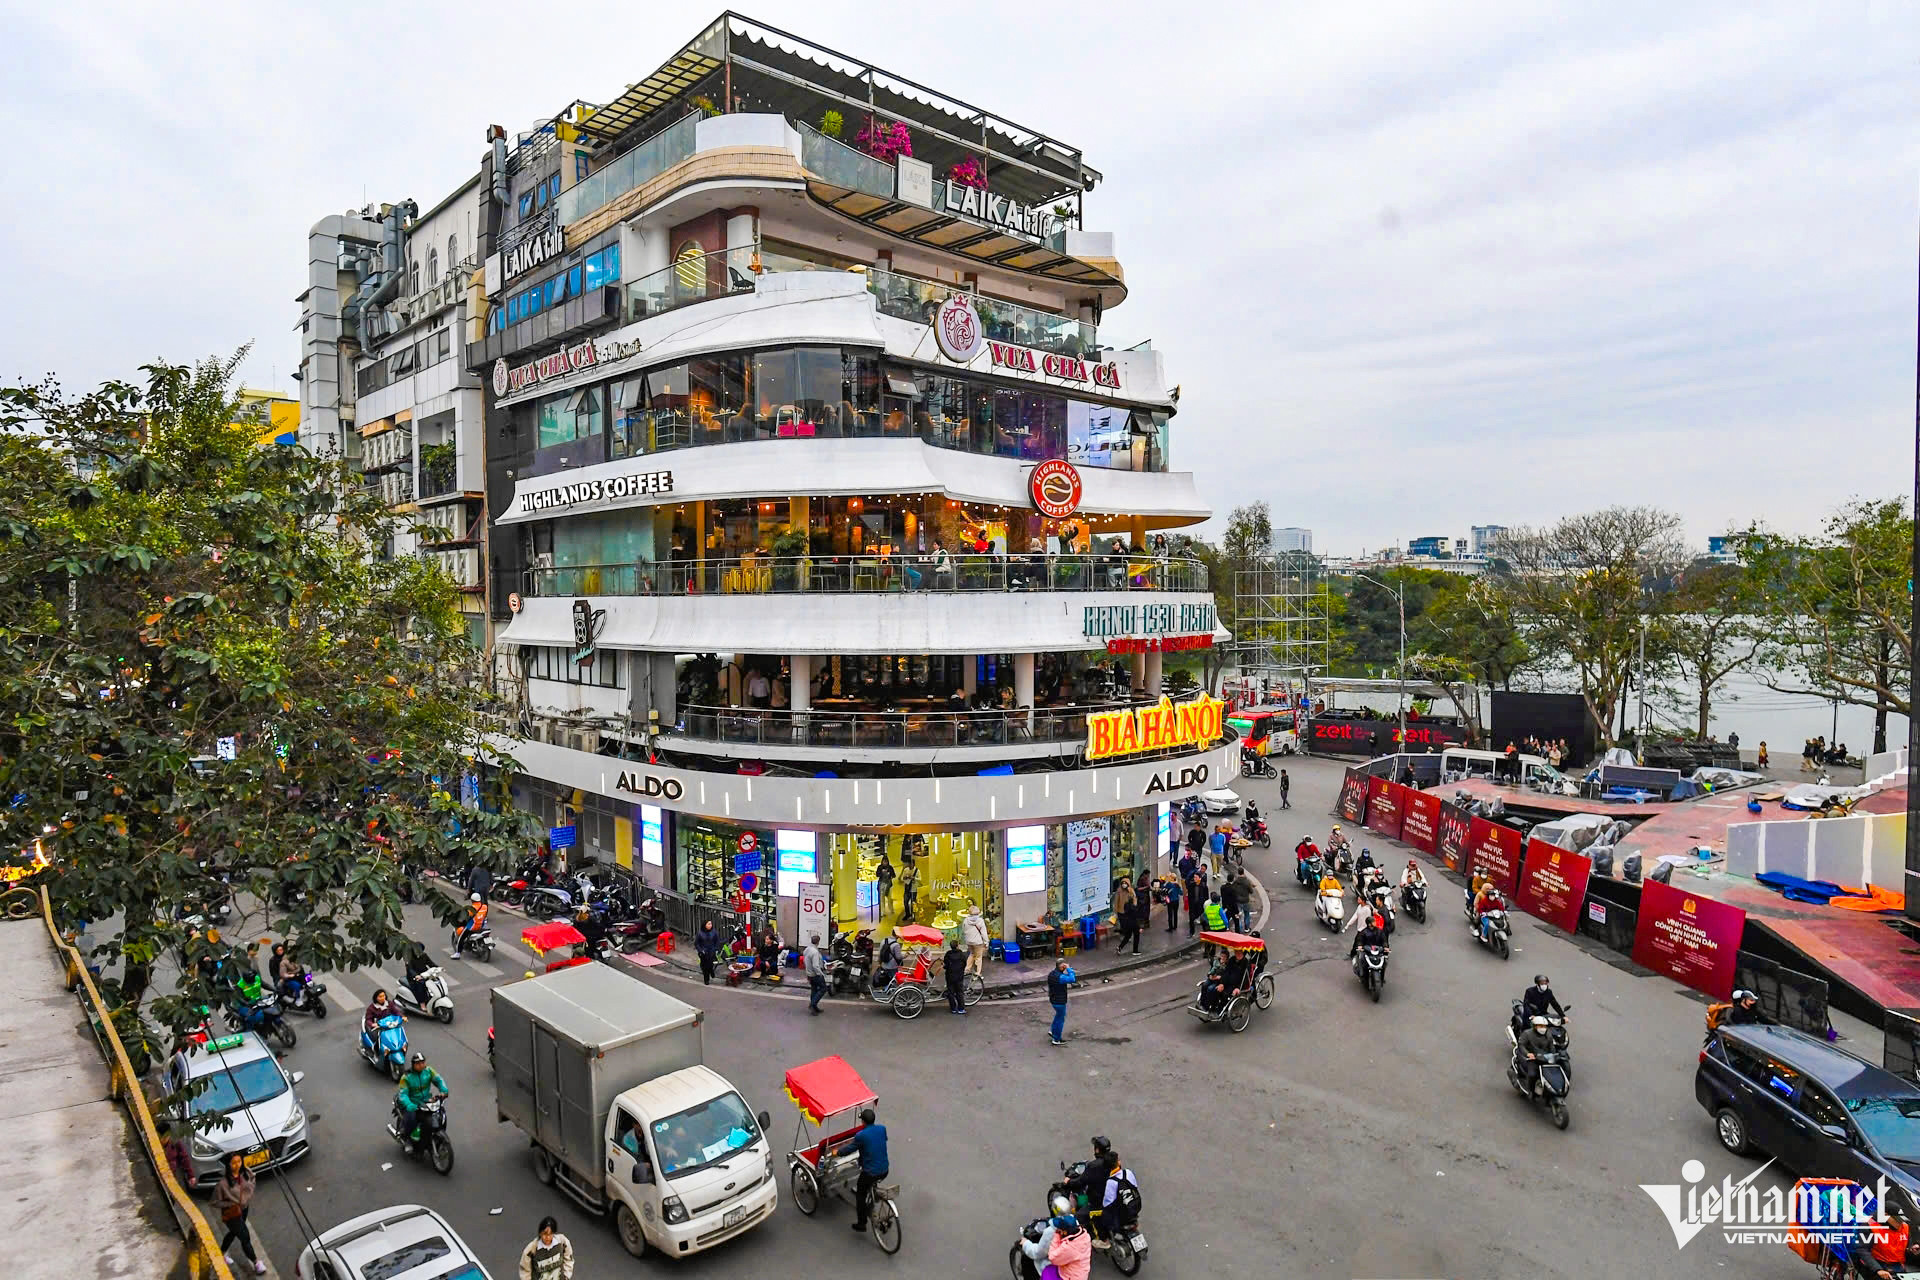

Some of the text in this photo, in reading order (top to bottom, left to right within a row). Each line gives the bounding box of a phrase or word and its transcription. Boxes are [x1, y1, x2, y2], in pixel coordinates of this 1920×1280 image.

[946, 178, 1022, 232] LAIKA
[503, 225, 565, 280] LAIKA Café
[539, 344, 570, 380] CHẢ
[573, 337, 597, 370] CÁ
[988, 341, 1121, 389] VUA CHẢ CÁ
[519, 471, 673, 512] HIGHLANDS COFFEE
[1035, 463, 1080, 489] HIGHLANDS
[1040, 500, 1075, 515] COFFEE
[1084, 602, 1217, 636] HANOI 1930 BISTRO
[1088, 692, 1224, 759] BIA HÀ NỘI
[616, 771, 683, 800] ALDO
[1145, 764, 1209, 795] ALDO
[1076, 836, 1102, 863] 50
[803, 898, 825, 914] 50
[1683, 924, 1706, 937] QUANG
[214, 1034, 242, 1048] TAXI
